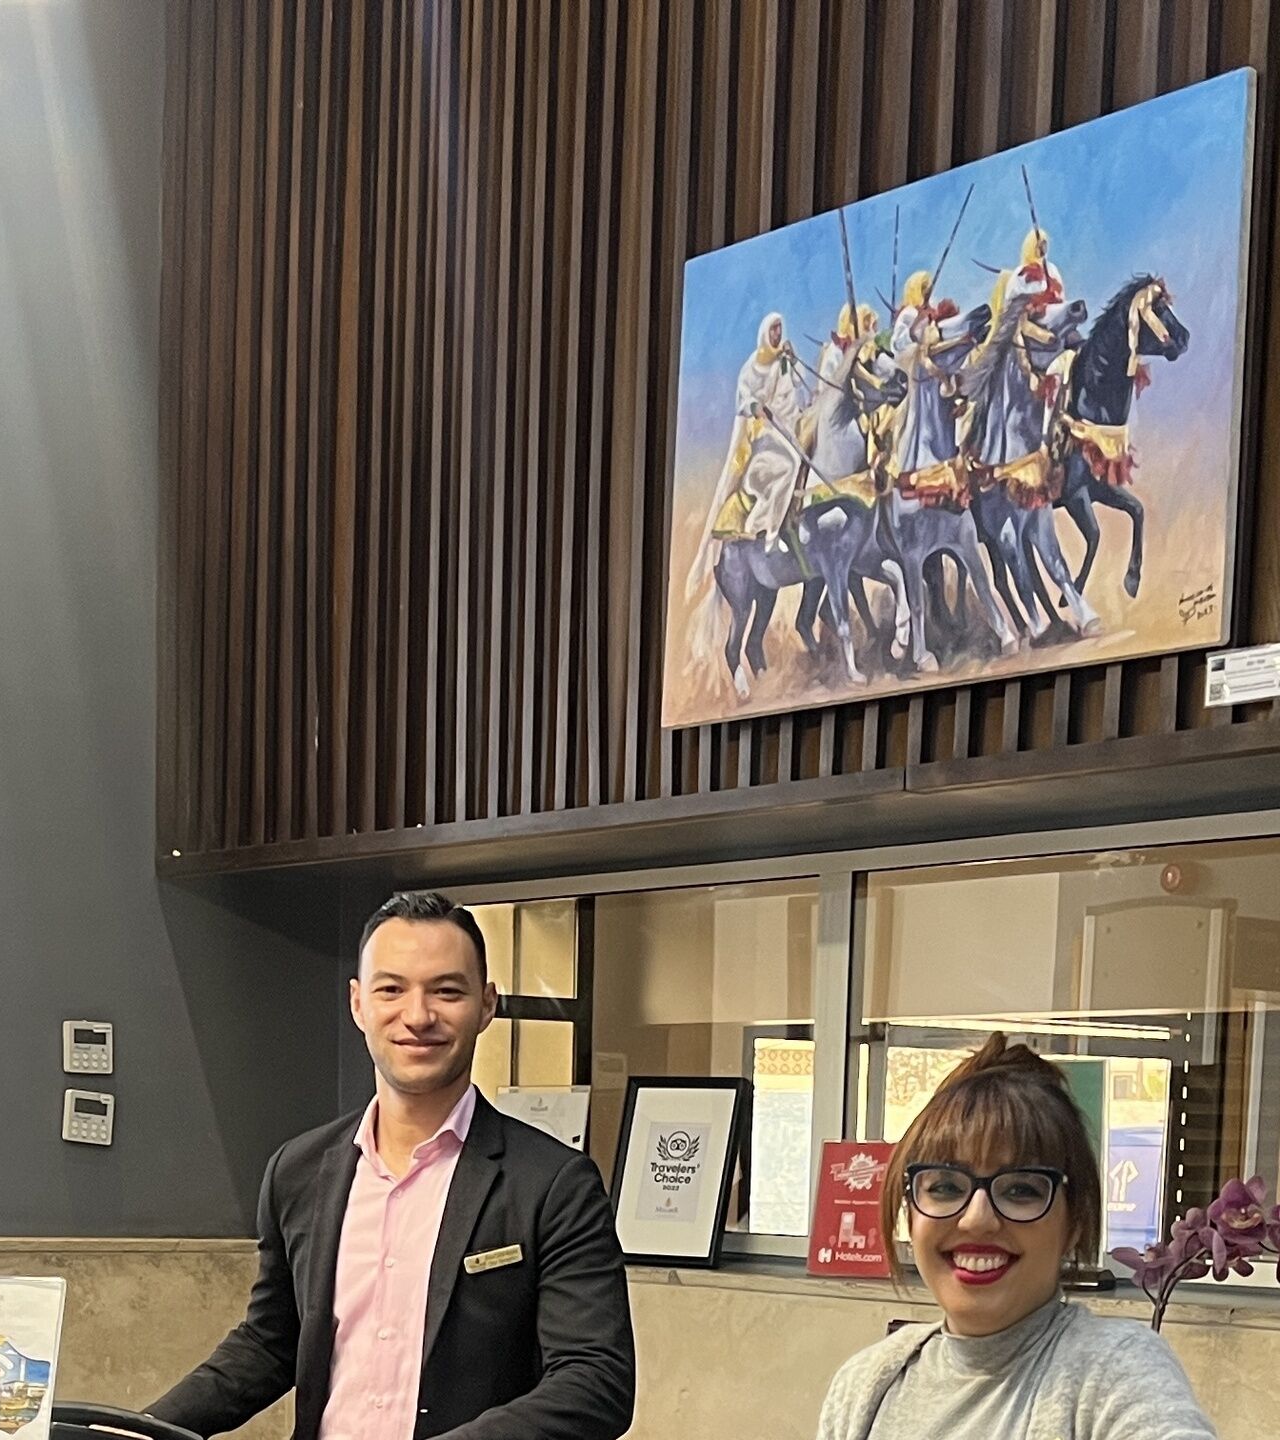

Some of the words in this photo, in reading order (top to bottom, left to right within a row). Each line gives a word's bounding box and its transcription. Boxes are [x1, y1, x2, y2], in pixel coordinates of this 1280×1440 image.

[650, 1161, 701, 1174] Travelers'
[653, 1172, 692, 1184] Choice
[834, 1251, 883, 1263] Hotels.com
